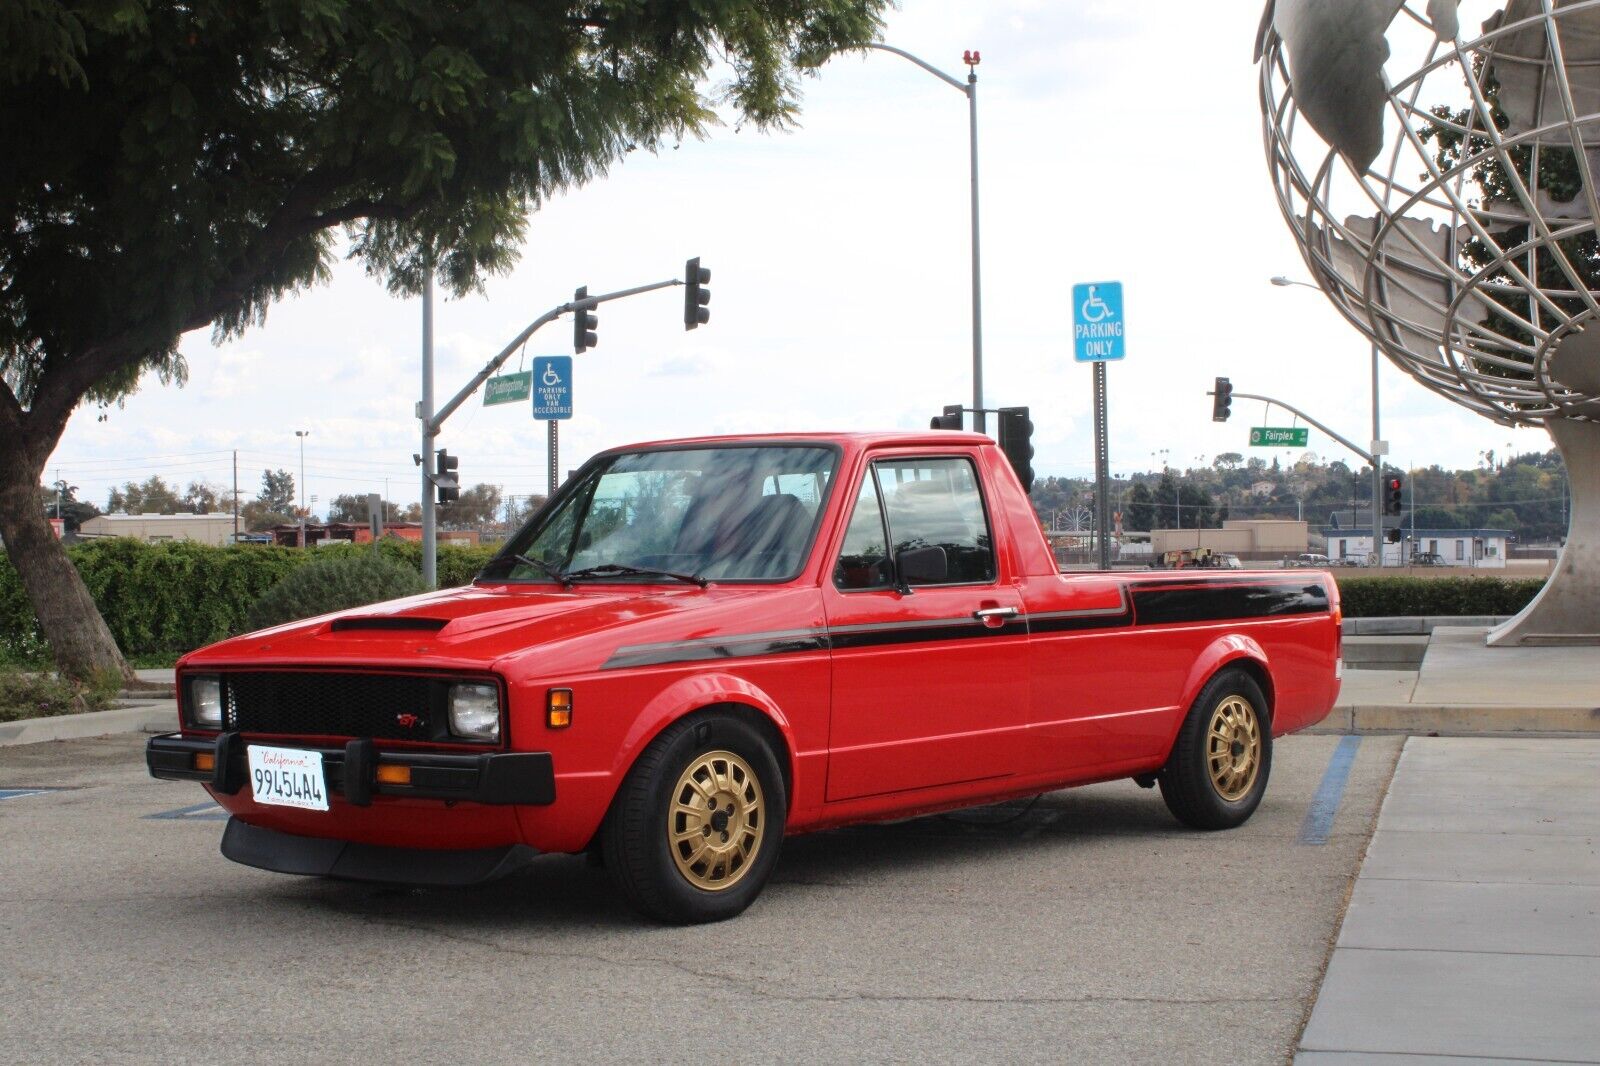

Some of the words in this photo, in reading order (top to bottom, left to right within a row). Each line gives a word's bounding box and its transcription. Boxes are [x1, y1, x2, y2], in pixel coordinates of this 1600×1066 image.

[1076, 321, 1122, 339] PARKING
[1086, 340, 1113, 356] ONLY
[534, 406, 572, 414] ACCESSIBLE
[1265, 430, 1294, 443] Fairplex
[263, 751, 304, 768] California
[255, 768, 322, 802] 99454A4
